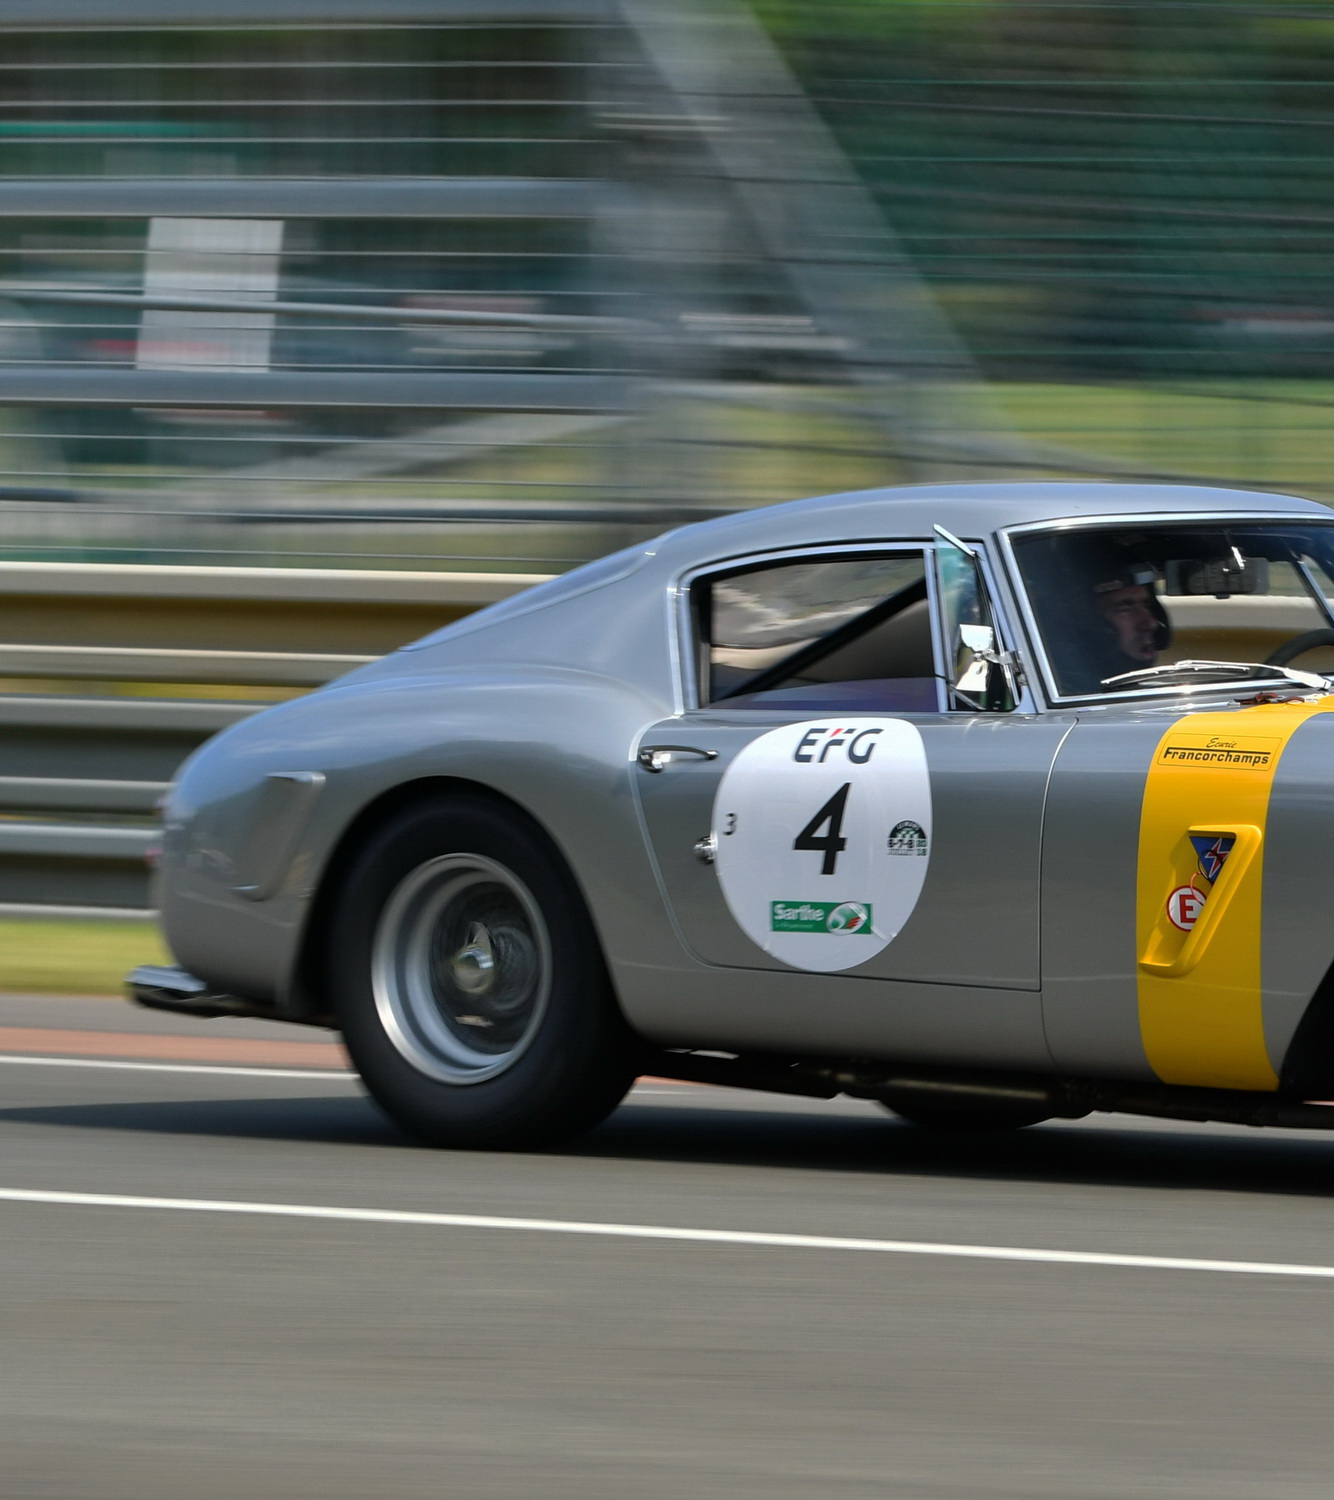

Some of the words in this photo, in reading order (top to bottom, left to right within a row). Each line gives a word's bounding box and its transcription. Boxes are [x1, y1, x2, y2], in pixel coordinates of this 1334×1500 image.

[793, 728, 884, 764] EFG
[1206, 737, 1237, 749] Ecurie
[1163, 747, 1271, 767] Francorchamps
[723, 812, 737, 836] 3
[792, 782, 853, 875] 4
[774, 903, 825, 921] Sarthe
[1179, 894, 1198, 923] E
